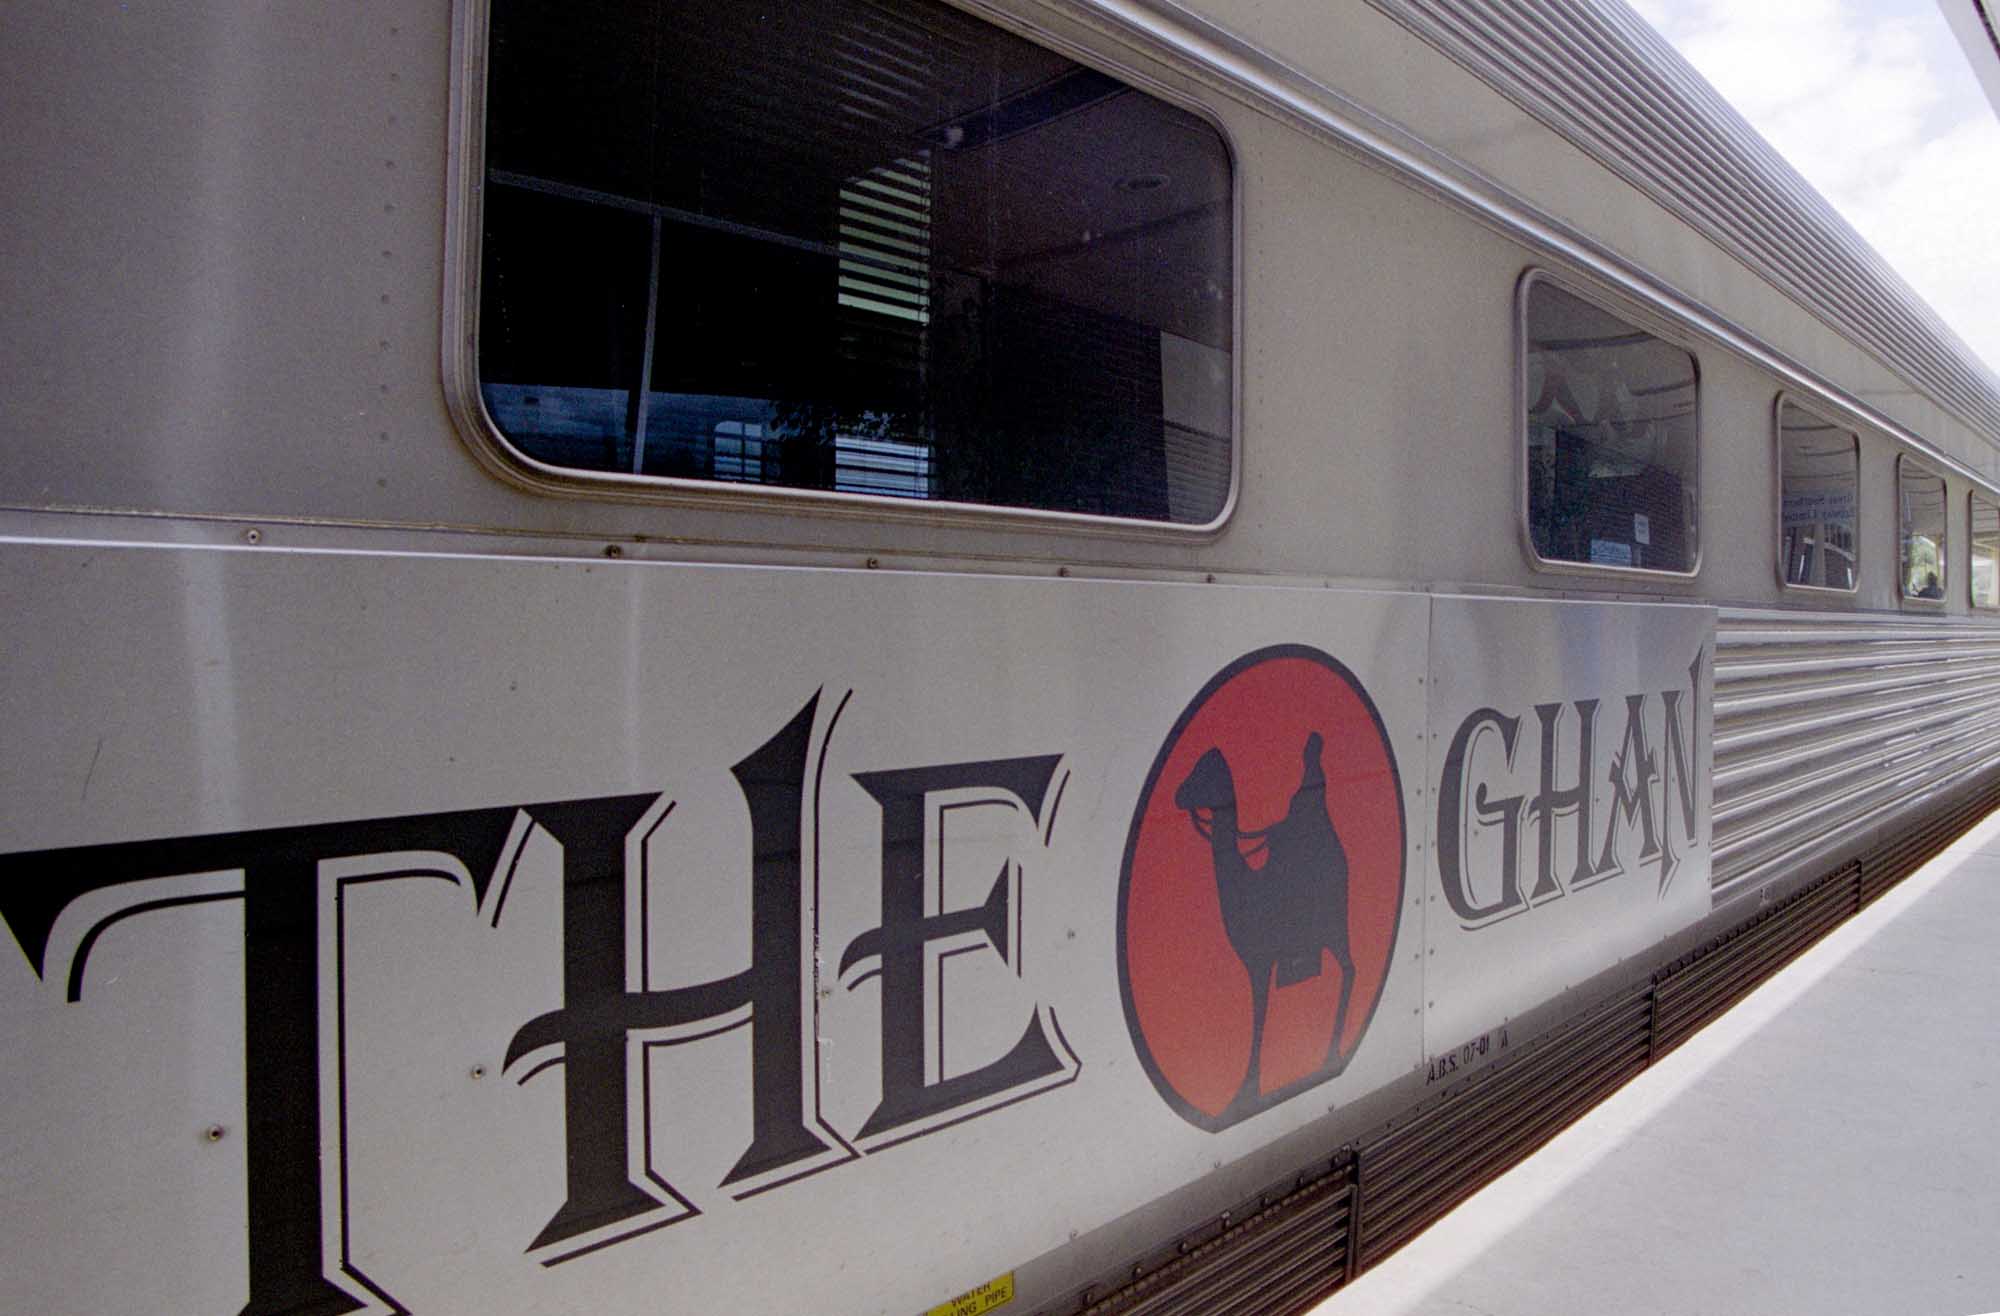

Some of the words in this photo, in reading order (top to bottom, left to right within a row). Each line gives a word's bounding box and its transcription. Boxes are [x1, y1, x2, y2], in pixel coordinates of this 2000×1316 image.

[0, 683, 1082, 1316] THE
[1437, 644, 1704, 931] GHAN
[984, 1285, 1009, 1307] PIPE
